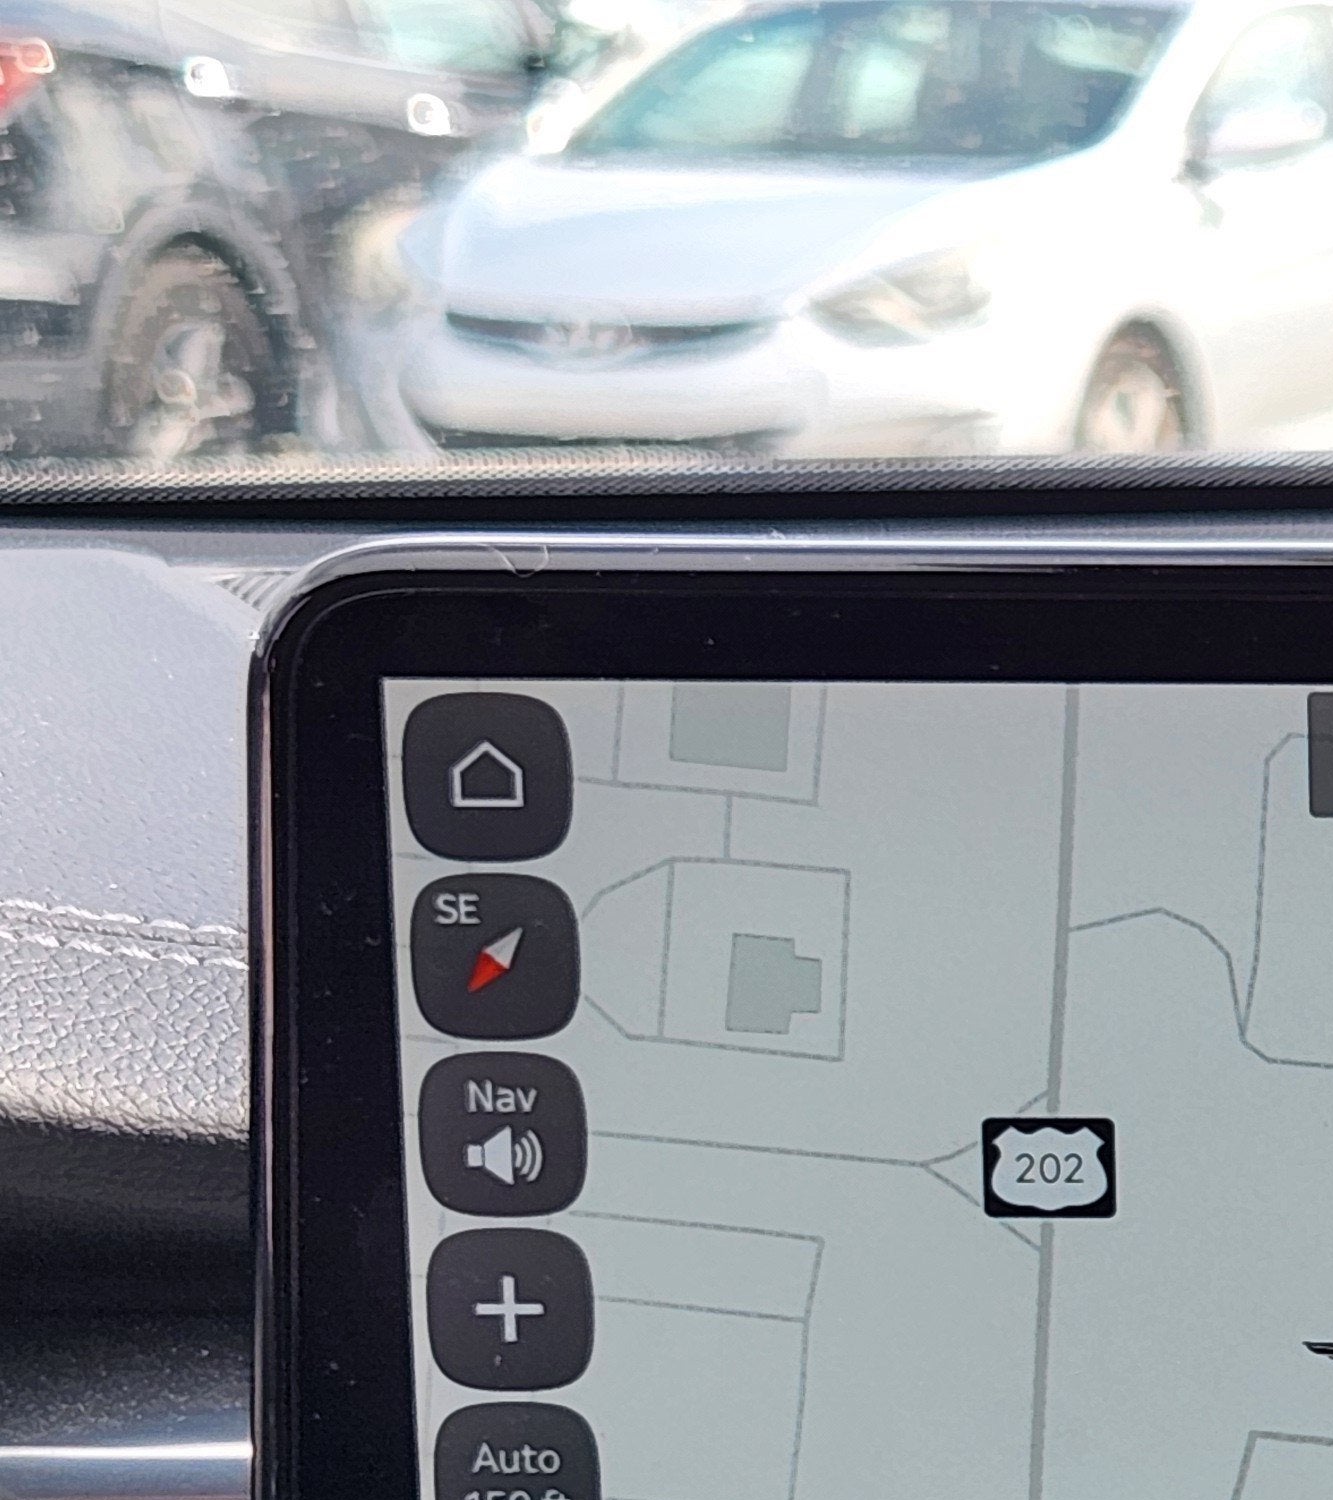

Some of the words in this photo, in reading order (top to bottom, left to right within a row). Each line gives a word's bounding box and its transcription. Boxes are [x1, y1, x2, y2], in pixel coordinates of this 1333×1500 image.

[434, 893, 481, 926] SE
[467, 1080, 538, 1114] Nav
[1014, 1152, 1086, 1185] 202
[471, 1442, 562, 1475] Auto
